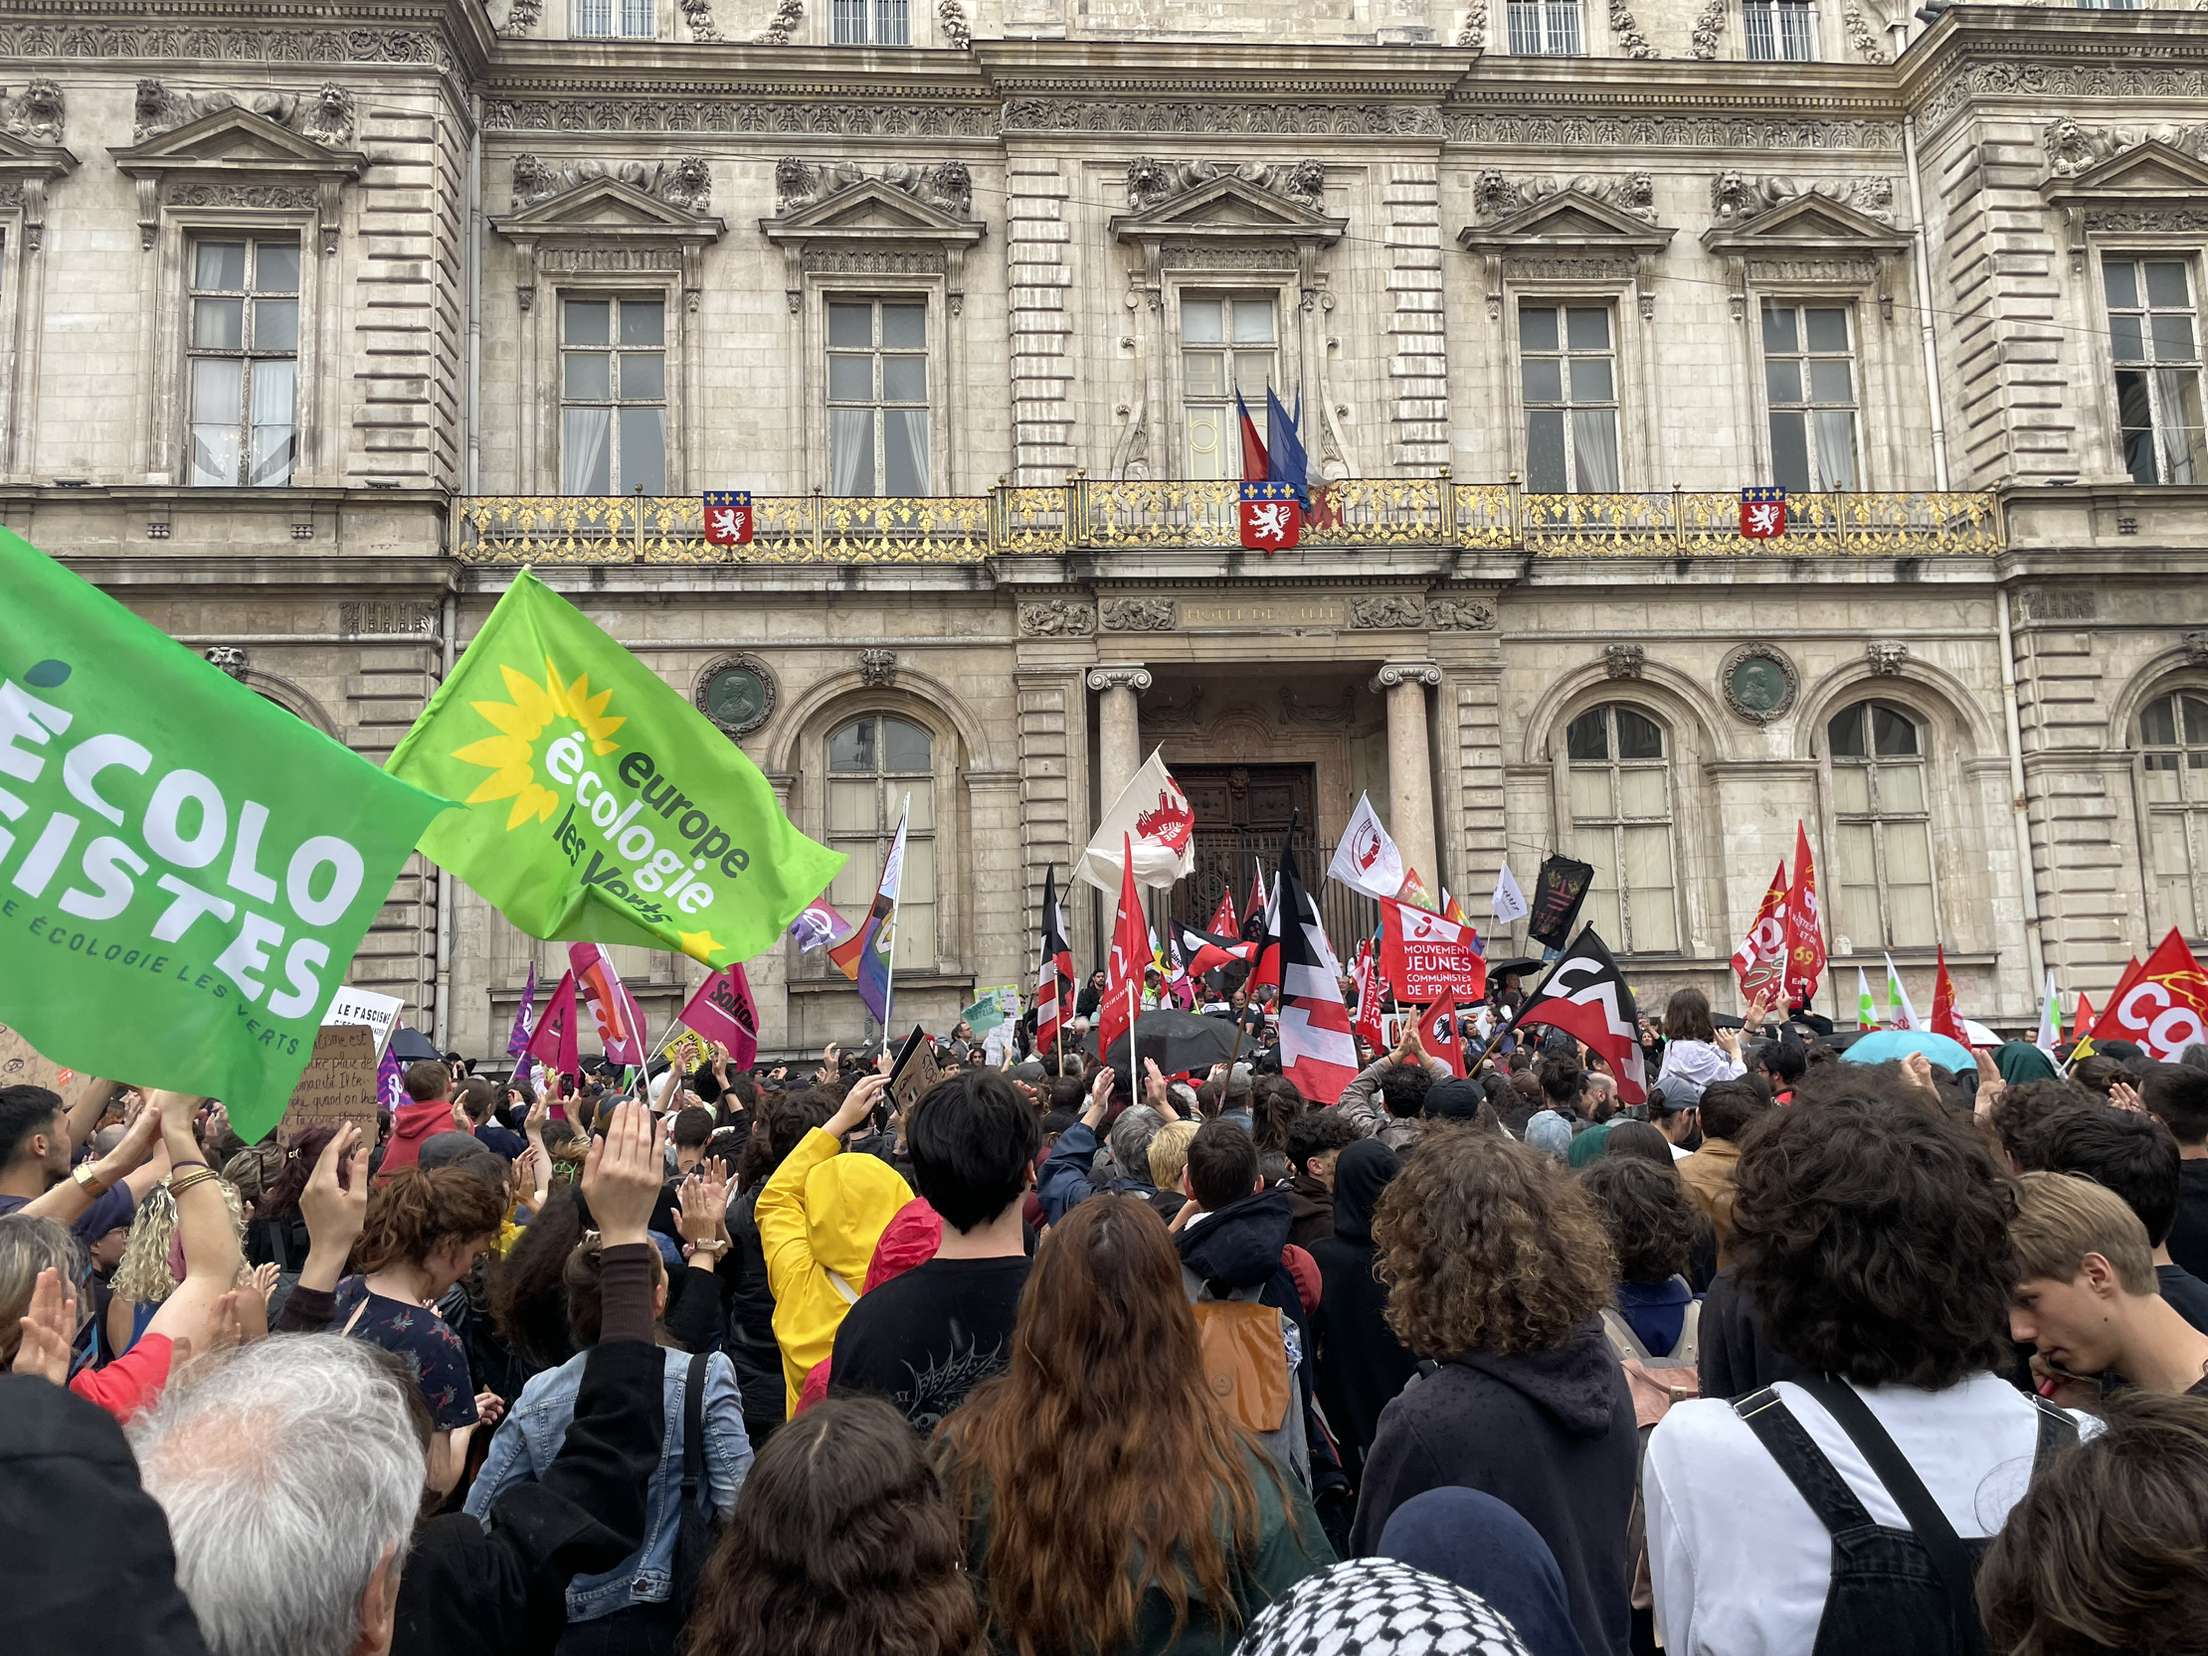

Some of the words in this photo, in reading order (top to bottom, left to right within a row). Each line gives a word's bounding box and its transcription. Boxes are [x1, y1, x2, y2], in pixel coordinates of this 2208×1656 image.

[545, 730, 715, 914] écologie
[552, 803, 587, 867] les
[618, 751, 750, 879] europe
[1405, 955, 1472, 972] JEUNES
[1406, 973, 1472, 983] COMMUNISTES
[30, 915, 168, 974] ÉCOLOGIE
[177, 966, 228, 998] LES
[236, 1003, 300, 1056] VERTS
[1407, 984, 1423, 996] DE
[1427, 984, 1473, 996] FRNCE
[338, 1003, 351, 1017] LE
[353, 1006, 392, 1025] FASCISME
